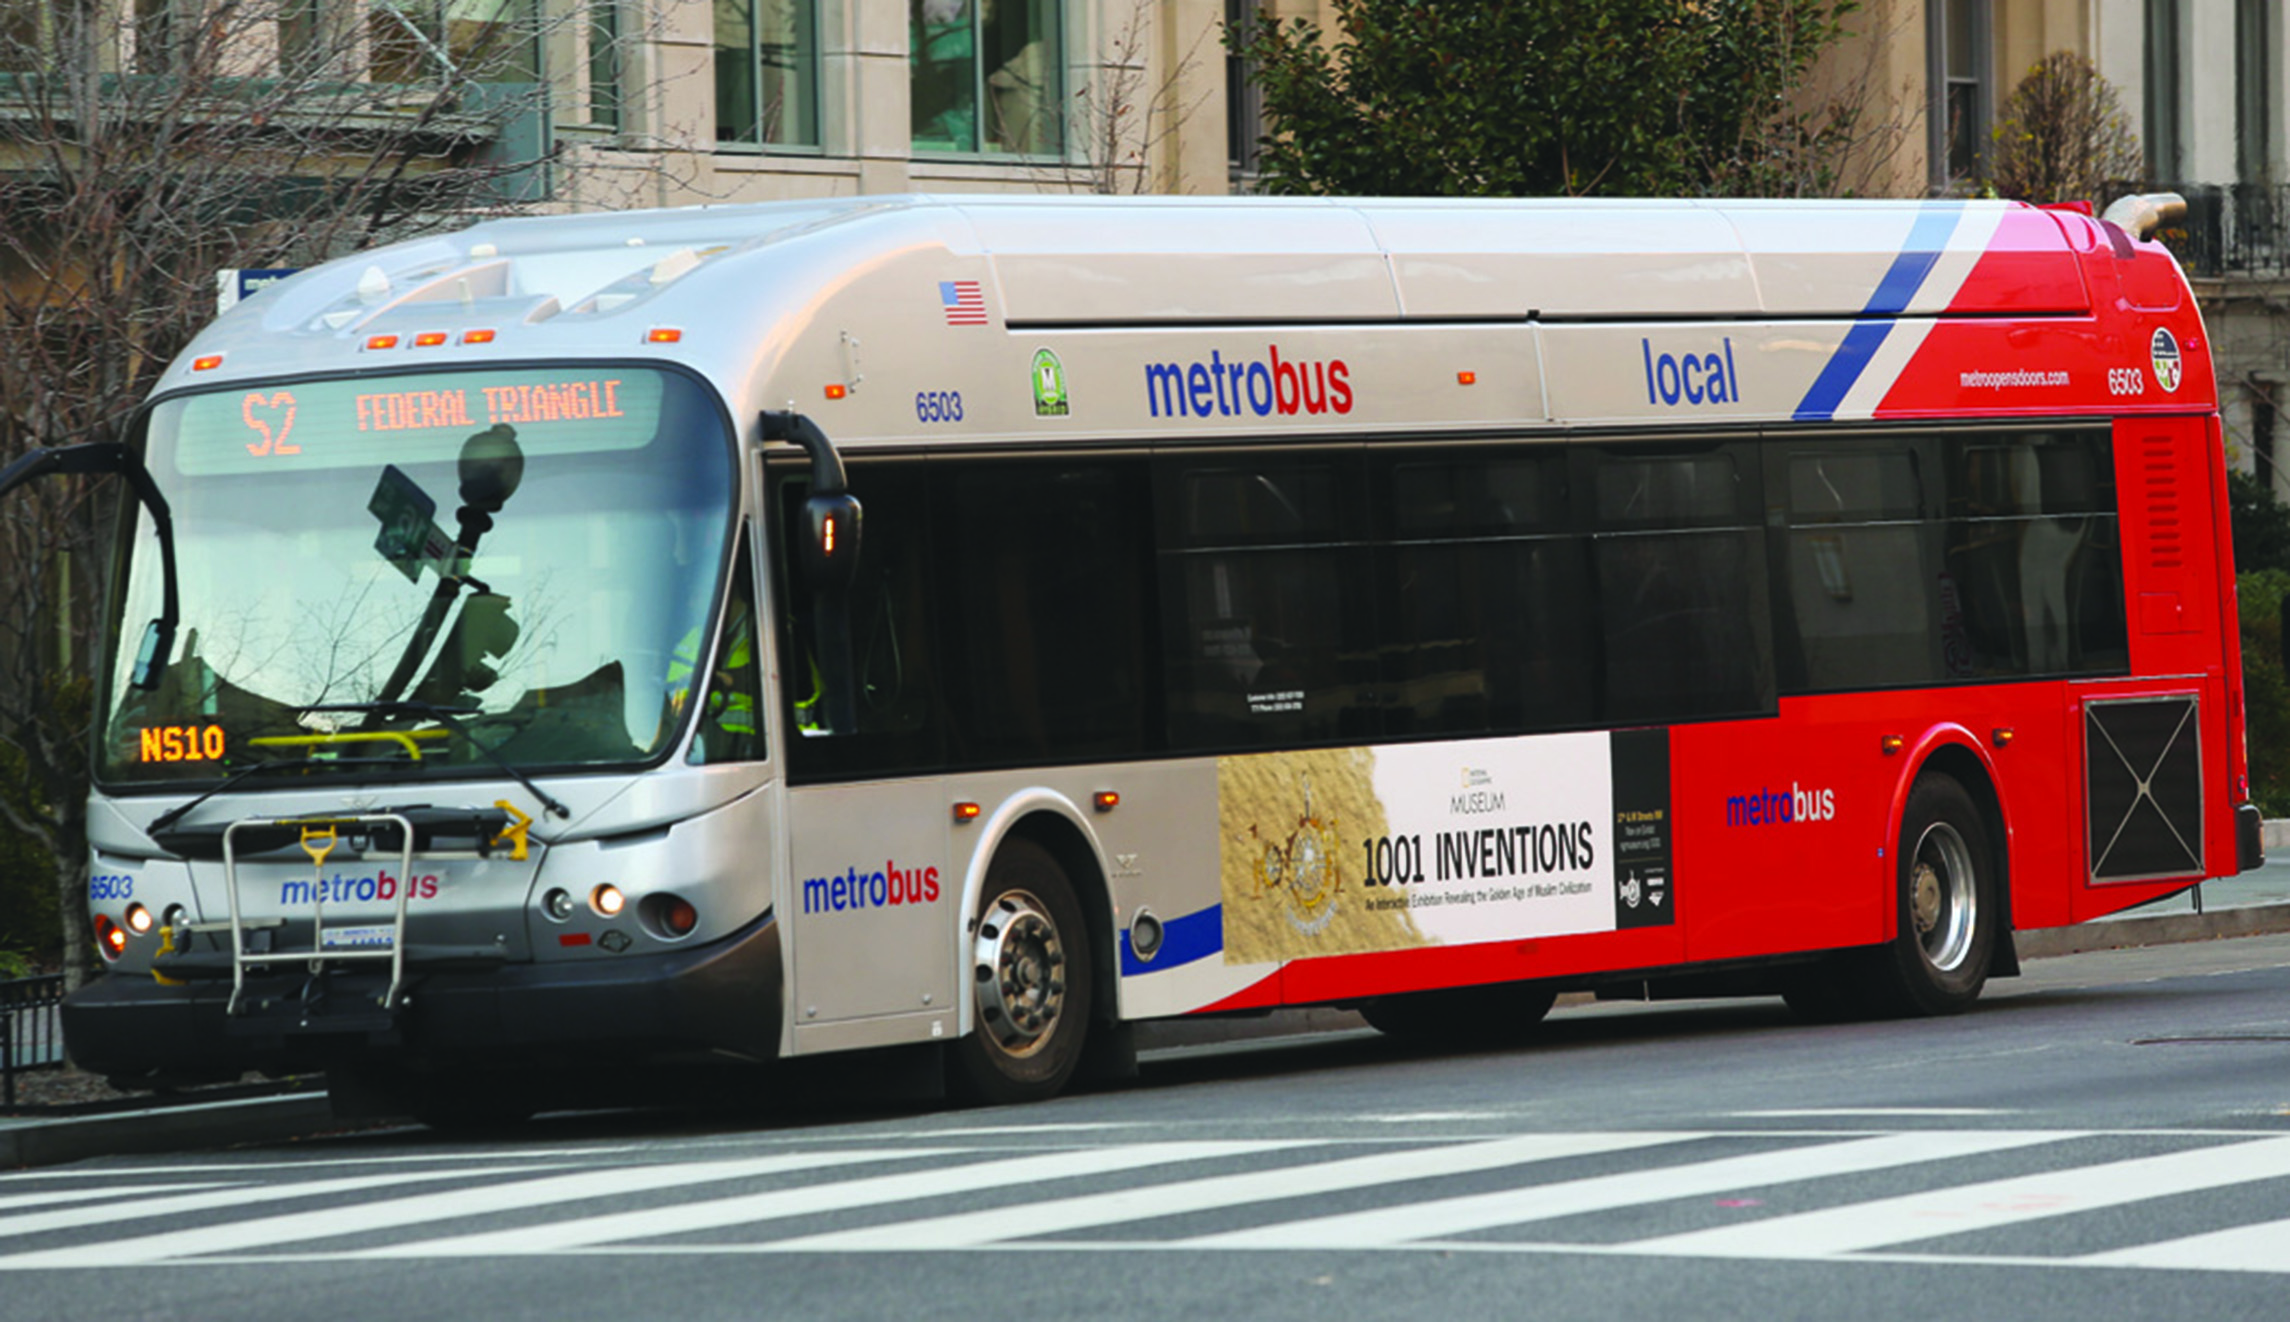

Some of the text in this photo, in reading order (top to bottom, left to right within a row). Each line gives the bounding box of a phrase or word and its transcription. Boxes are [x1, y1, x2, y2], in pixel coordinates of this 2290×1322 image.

[1145, 344, 1354, 418] metrobus
[1642, 337, 1739, 406] local
[1960, 368, 2070, 391] metroopensdoors.com
[2108, 368, 2144, 395] 6503
[242, 380, 625, 456] S2 FEDERAL TRIANGLE
[916, 391, 964, 422] 6503
[141, 724, 225, 762] NS10
[1450, 791, 1506, 815] MUSEUM
[1727, 781, 1835, 827] metrobus
[1363, 821, 1594, 888] 1001 INVENTIONS
[803, 859, 940, 914] metrobus
